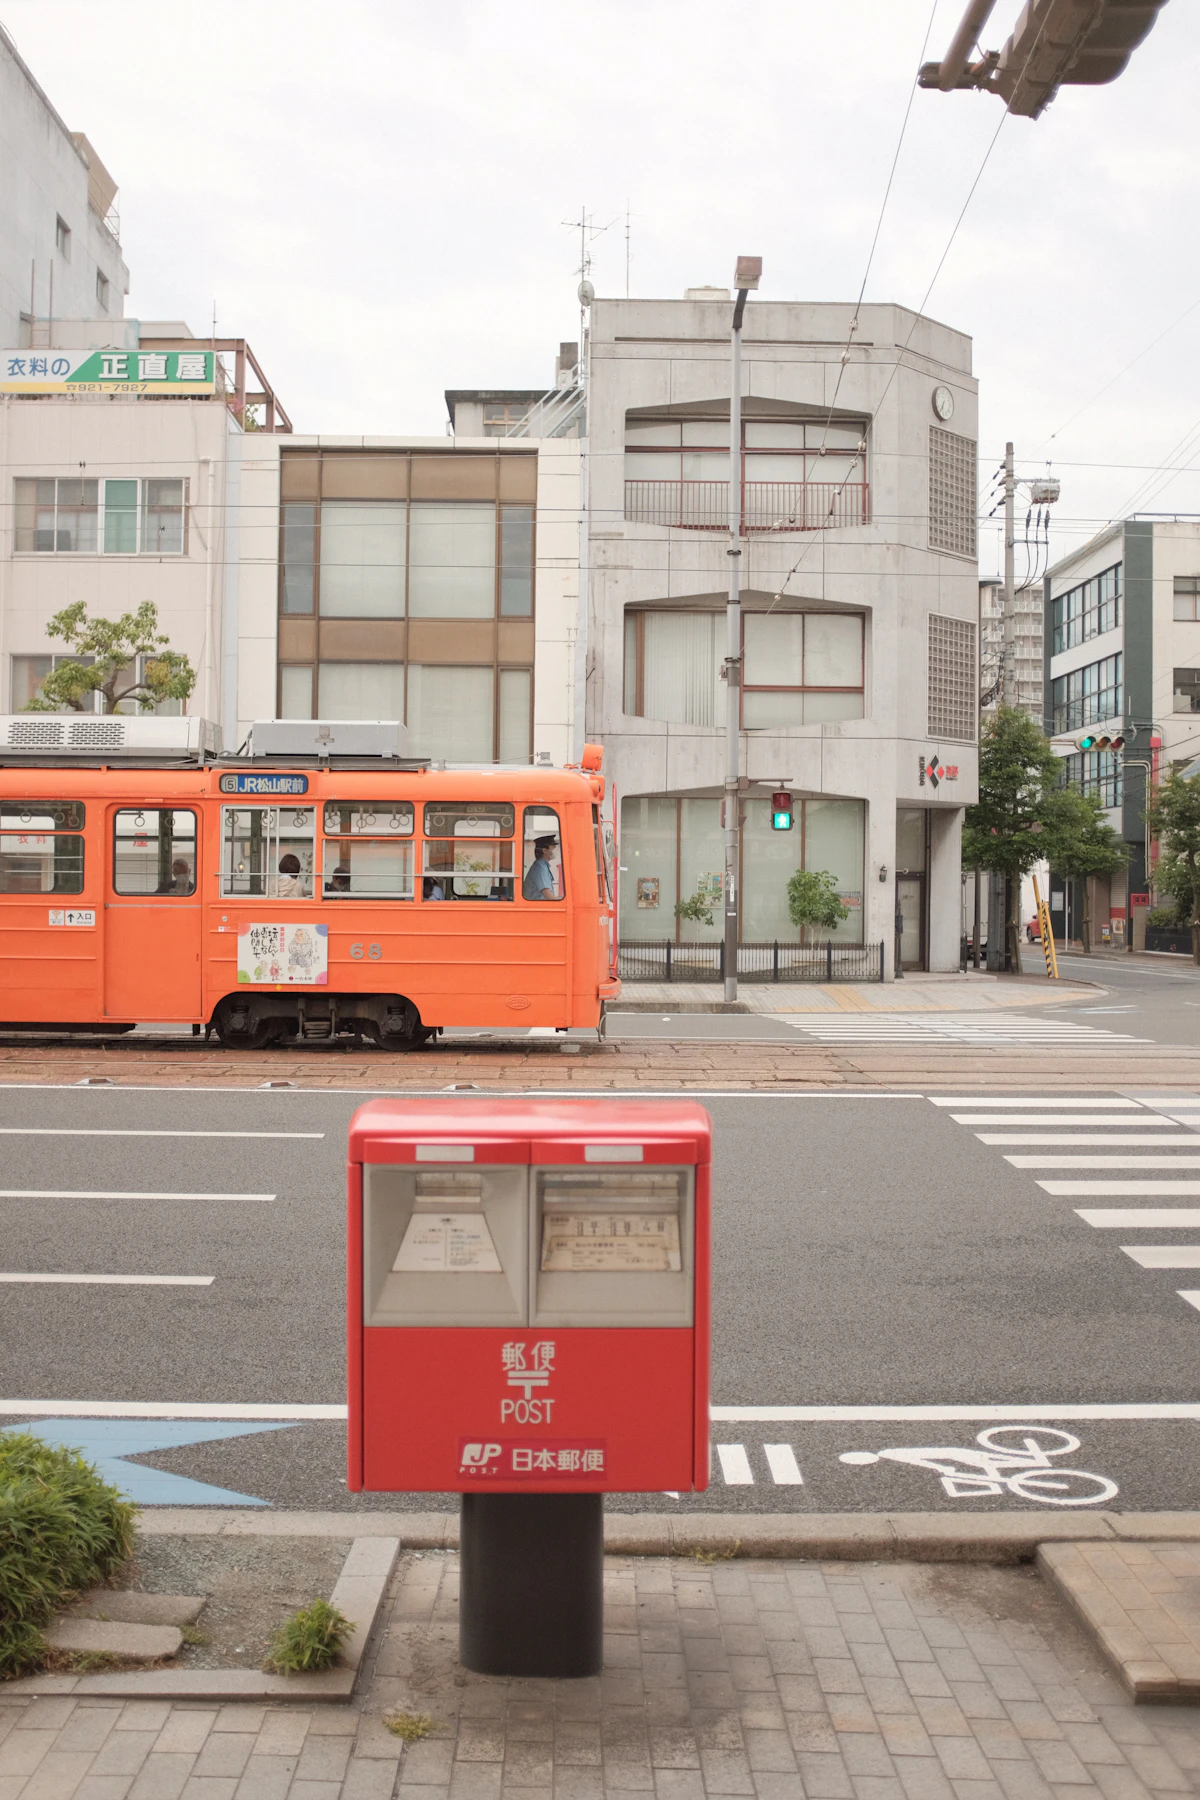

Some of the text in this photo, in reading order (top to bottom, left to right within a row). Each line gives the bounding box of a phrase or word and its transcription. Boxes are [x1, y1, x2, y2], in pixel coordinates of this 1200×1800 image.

[7, 353, 207, 381] 衣料の 正直屋
[78, 383, 148, 392] 921-7927
[239, 777, 304, 793] JR松山駅前
[250, 928, 261, 960] 仲間たち
[350, 943, 382, 960] 68
[502, 1341, 556, 1371] 郵便
[501, 1399, 556, 1424] POST
[461, 1443, 502, 1466] JP
[512, 1448, 604, 1472] 日本郵便
[459, 1467, 498, 1475] POST
